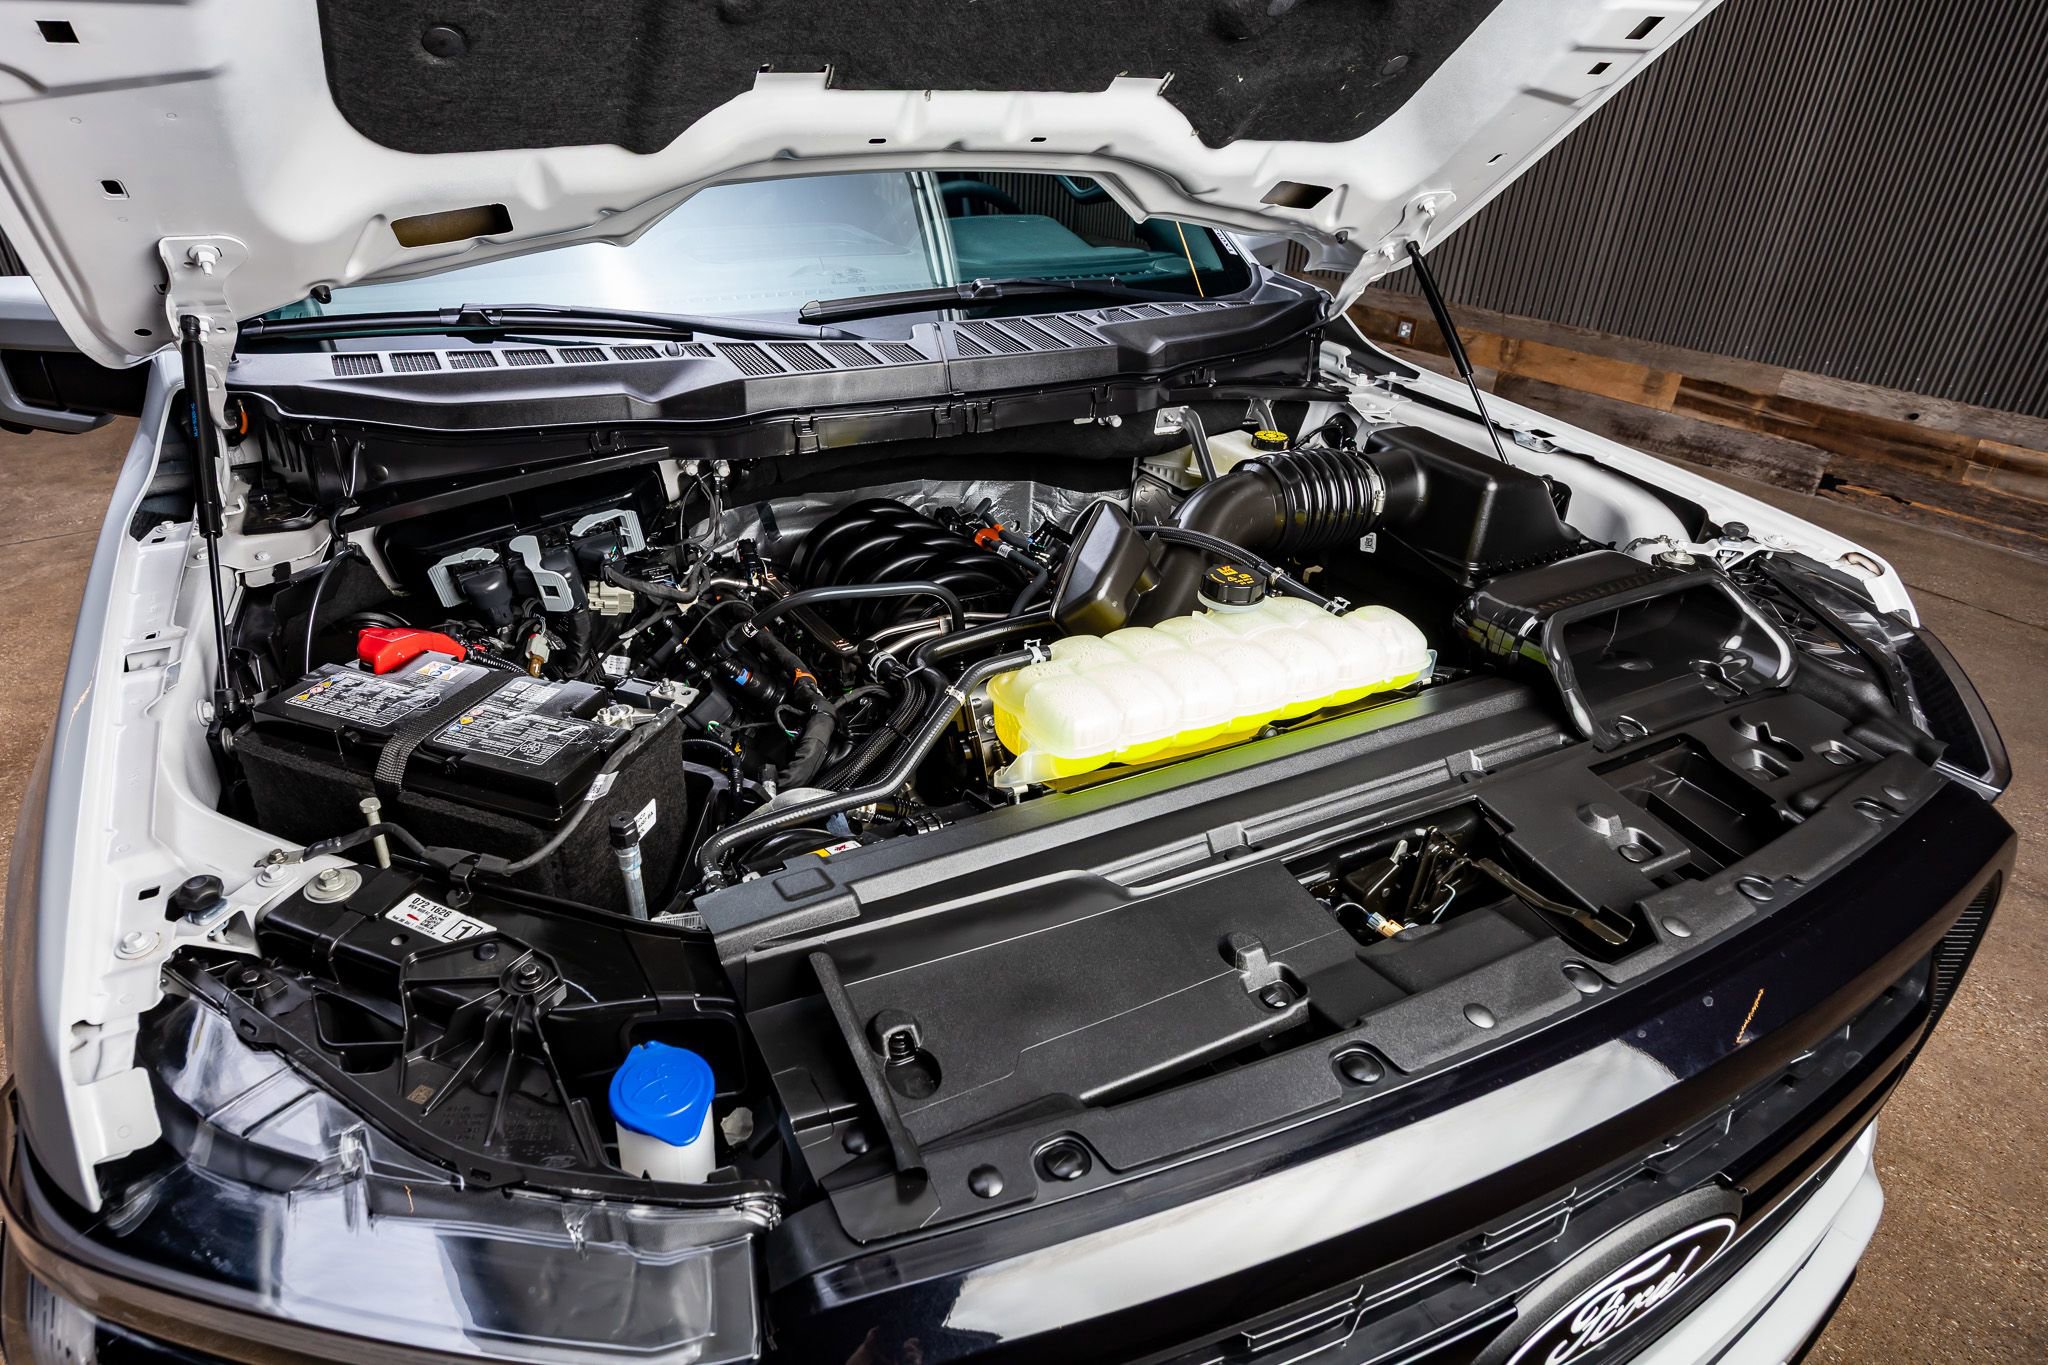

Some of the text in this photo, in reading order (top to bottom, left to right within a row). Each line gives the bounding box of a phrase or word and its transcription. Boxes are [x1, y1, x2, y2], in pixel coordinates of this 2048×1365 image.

[412, 897, 430, 908] 072
[430, 905, 452, 918] 1626
[455, 925, 473, 940] 1
[1545, 1245, 1701, 1365] Ford
